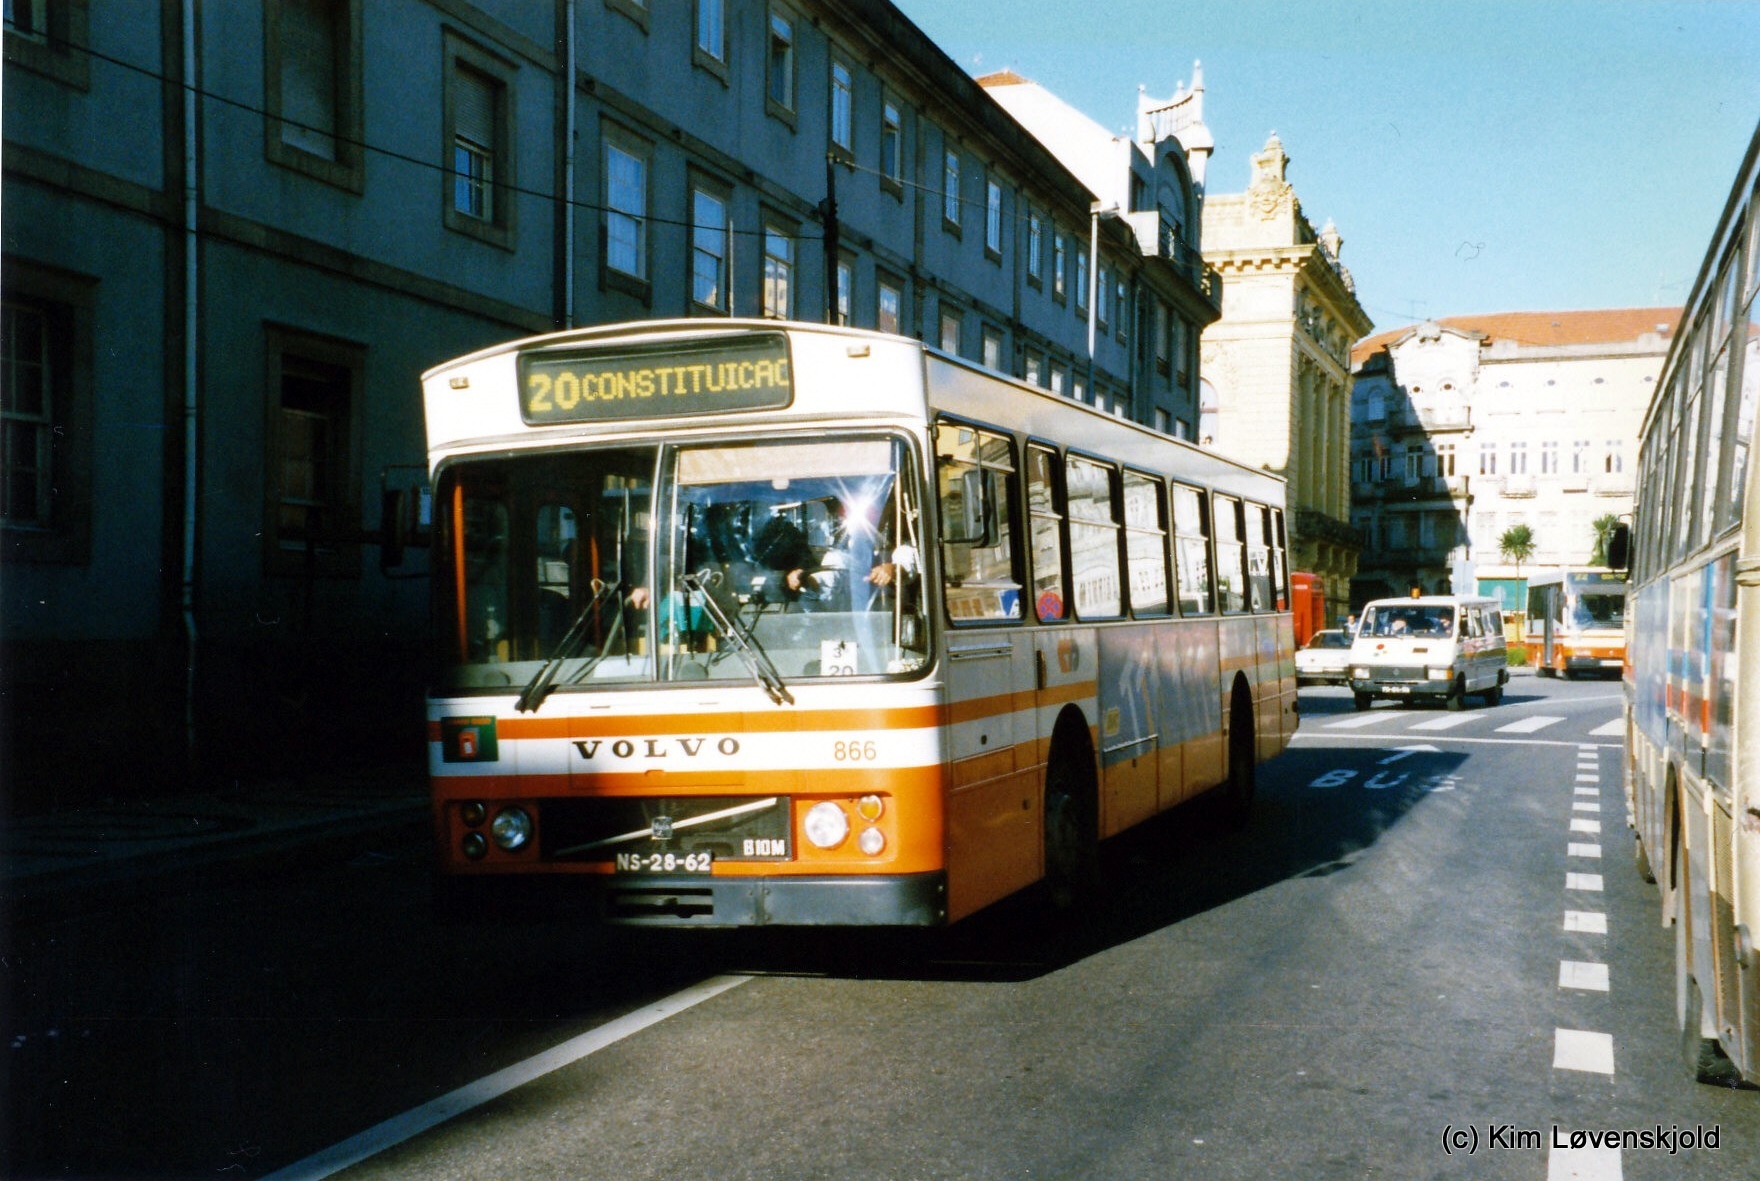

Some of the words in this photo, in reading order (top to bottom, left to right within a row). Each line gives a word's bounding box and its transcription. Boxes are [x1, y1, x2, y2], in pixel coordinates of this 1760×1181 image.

[529, 371, 580, 412] 20
[572, 737, 741, 760] VOLVO
[834, 740, 877, 761] 866
[743, 839, 785, 856] B10M
[616, 853, 711, 872] NS-28-62
